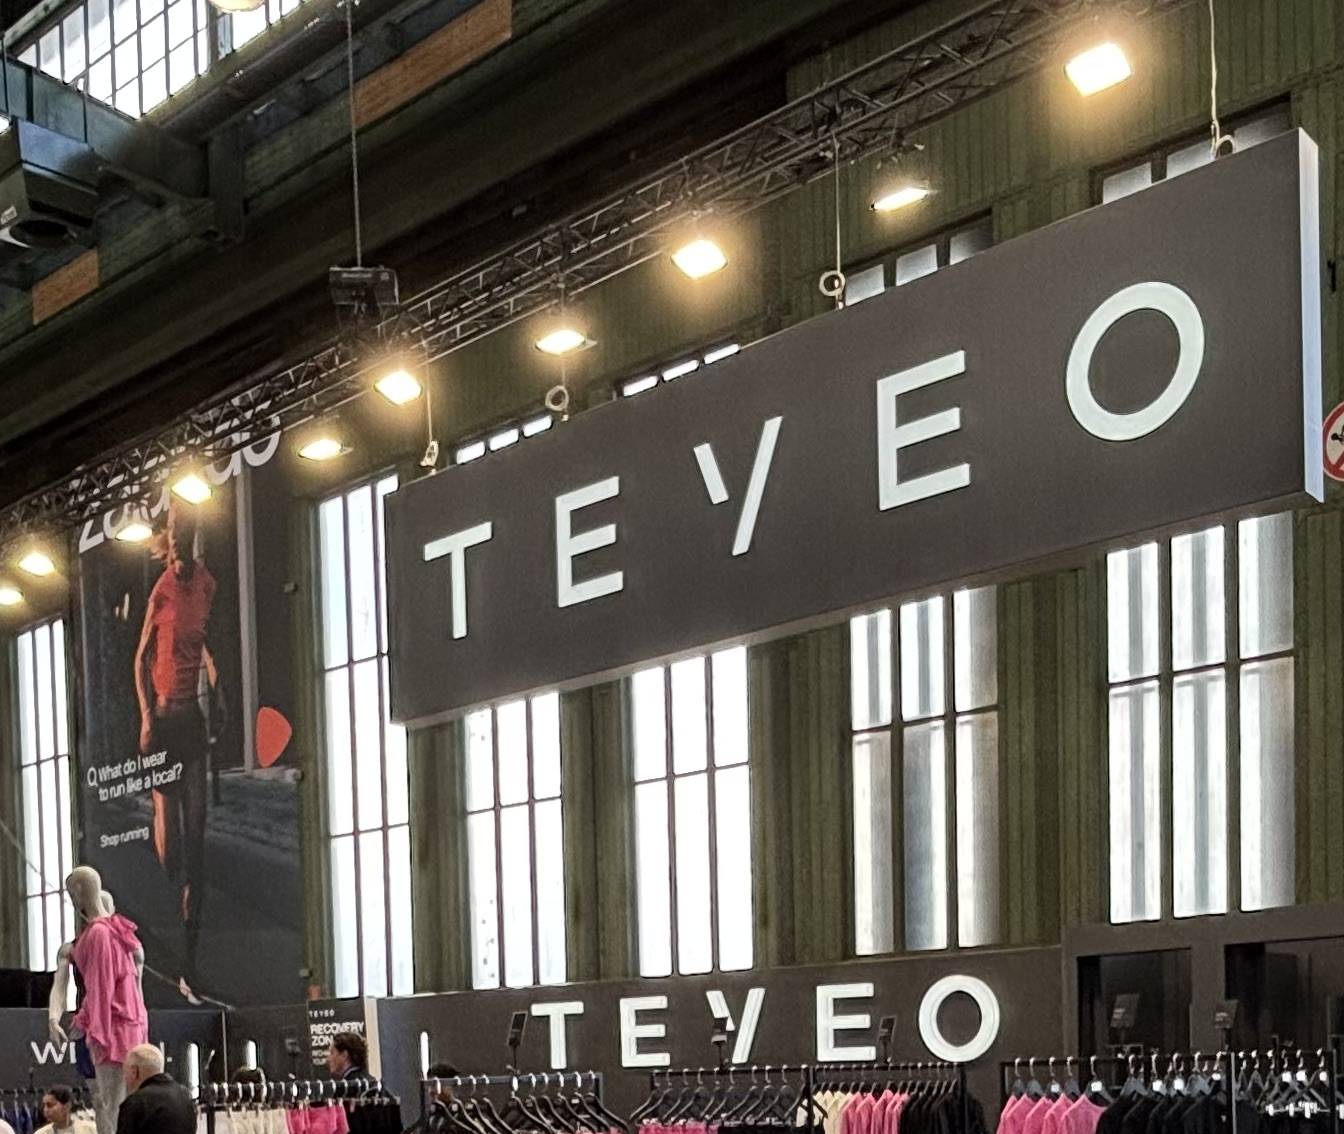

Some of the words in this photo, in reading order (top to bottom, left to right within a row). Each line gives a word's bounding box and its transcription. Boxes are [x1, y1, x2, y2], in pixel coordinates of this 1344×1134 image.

[423, 281, 1205, 640] TEVEO
[98, 763, 122, 782] What
[123, 758, 136, 775] do
[142, 751, 167, 769] wear
[98, 787, 109, 802] to
[109, 784, 125, 799] run
[126, 777, 143, 793] like
[144, 776, 151, 789] a
[152, 762, 183, 786] local?
[100, 834, 119, 848] Shop
[120, 826, 149, 843] running
[310, 1021, 364, 1035] RECOVERY
[531, 974, 1001, 1070] TEVEO
[311, 1035, 334, 1047] ZON
